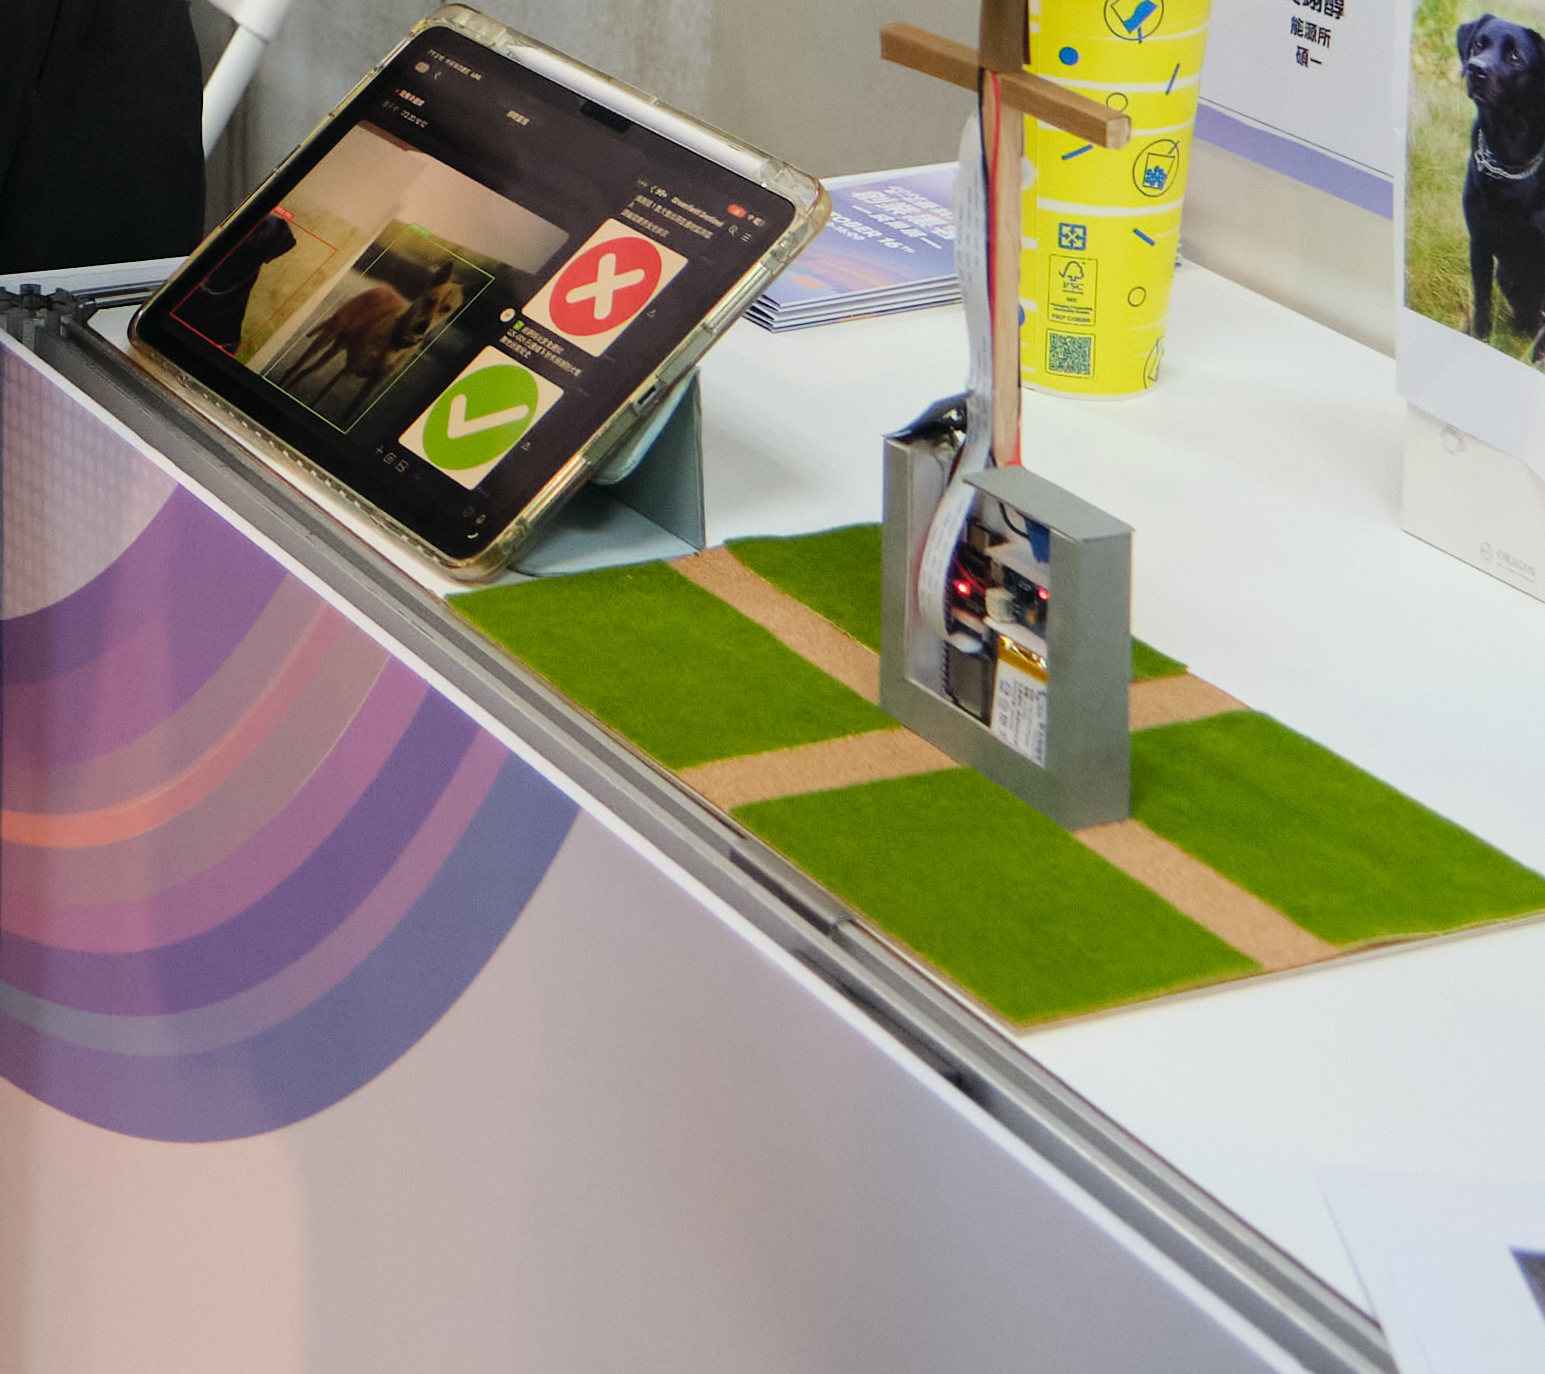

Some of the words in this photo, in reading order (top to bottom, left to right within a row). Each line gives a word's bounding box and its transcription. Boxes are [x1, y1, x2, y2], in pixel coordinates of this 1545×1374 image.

[1290, 15, 1332, 49] 能源所
[1295, 44, 1323, 68] 碩一
